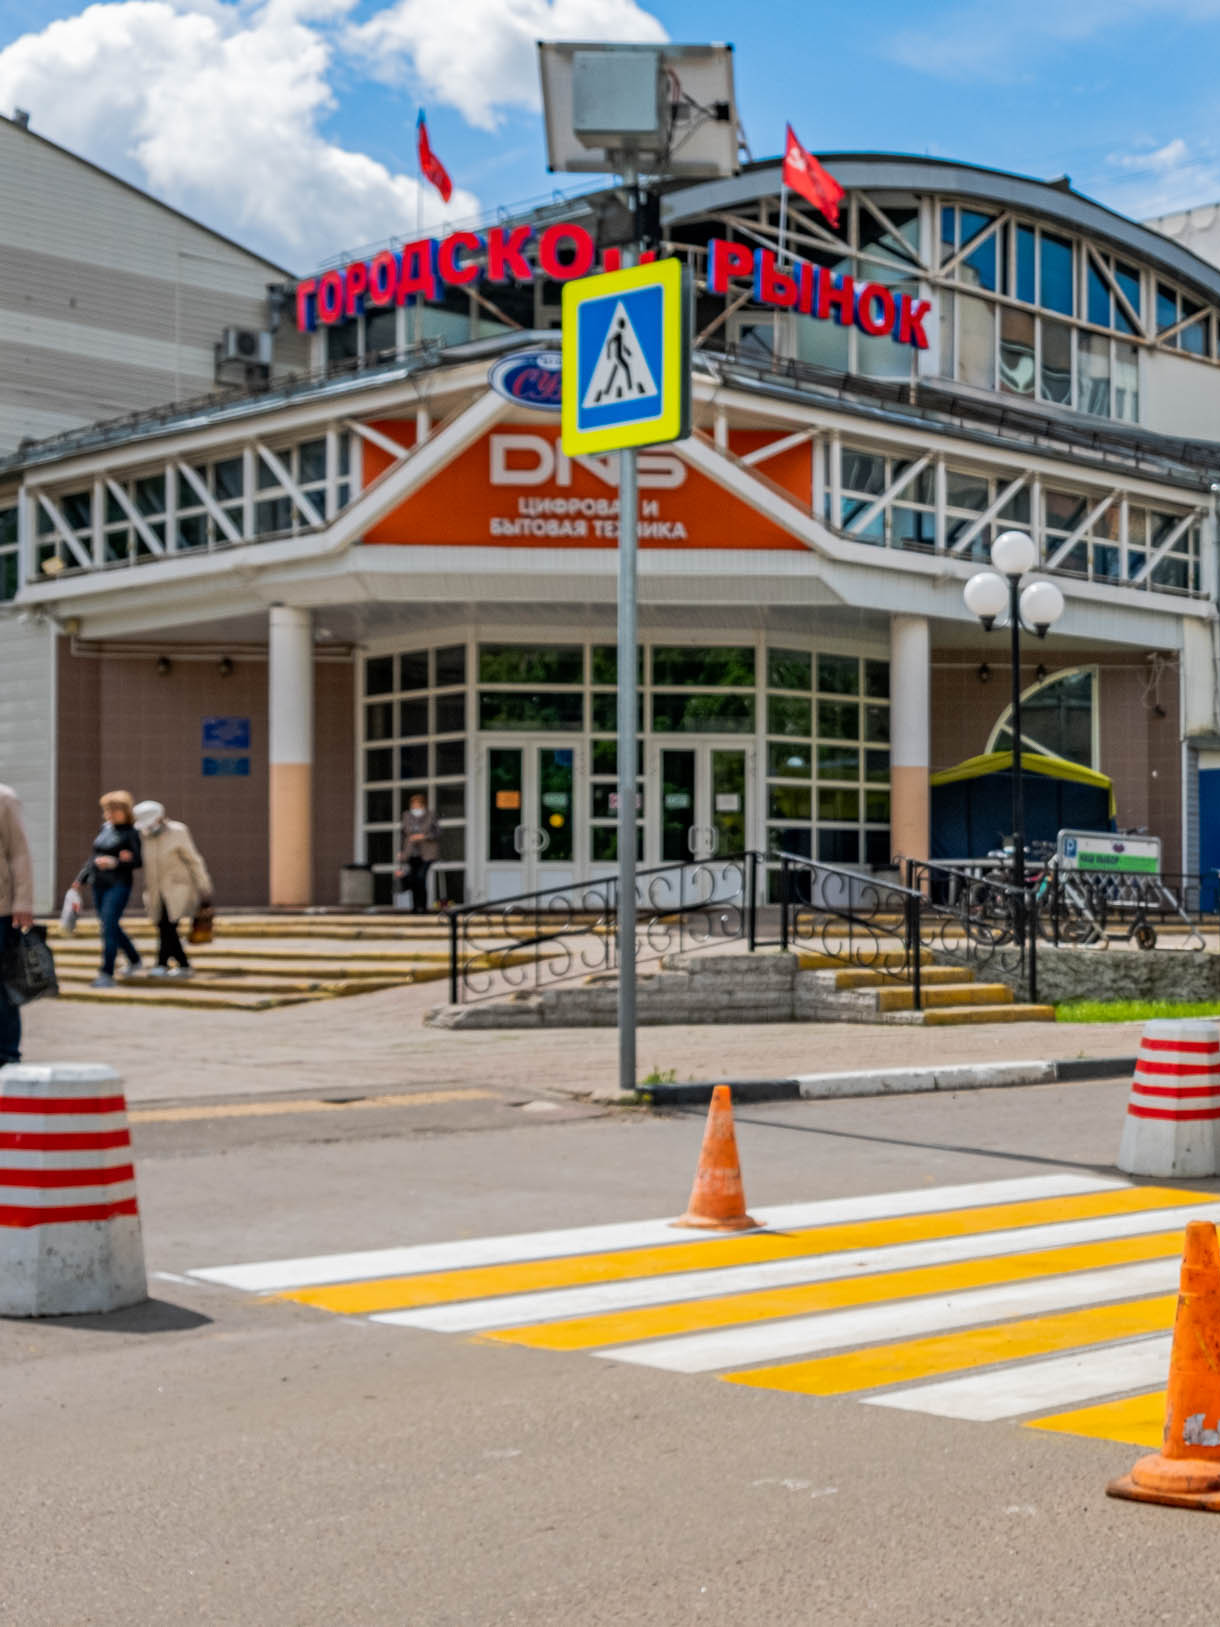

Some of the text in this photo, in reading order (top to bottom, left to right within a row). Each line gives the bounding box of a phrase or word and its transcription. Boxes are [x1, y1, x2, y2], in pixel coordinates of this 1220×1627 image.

[708, 238, 931, 349] РЫНОК
[518, 496, 659, 517] ЦИФРОВА И
[490, 517, 587, 537] БЫТОВАЯ
